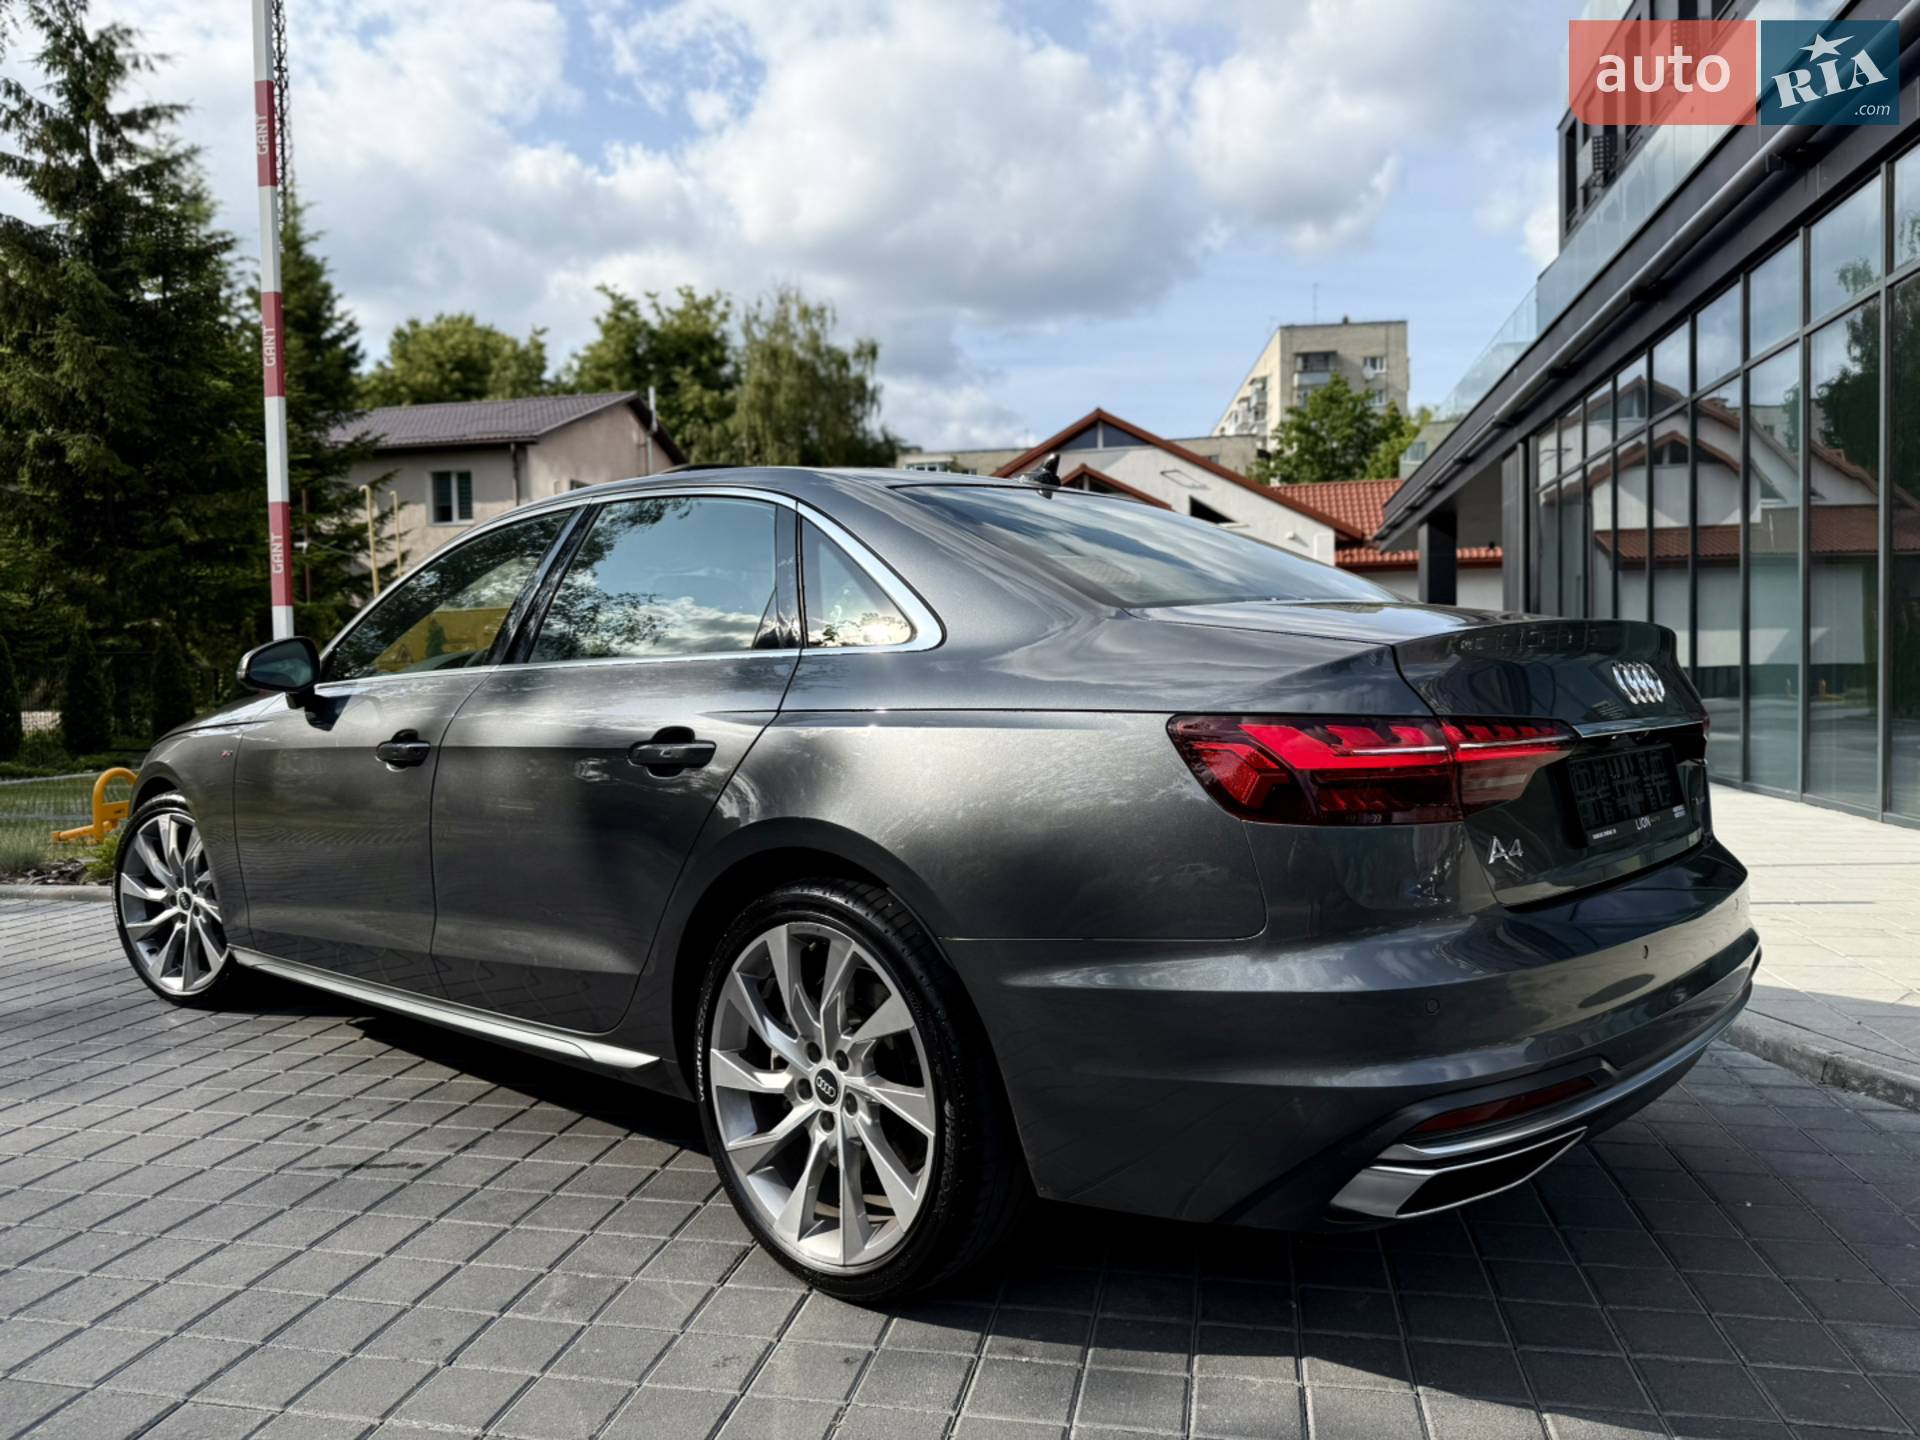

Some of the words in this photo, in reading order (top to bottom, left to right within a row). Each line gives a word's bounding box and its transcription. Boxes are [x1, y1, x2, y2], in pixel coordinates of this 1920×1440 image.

[262, 325, 275, 367] GANT
[270, 532, 284, 574] GANT
[1635, 815, 1652, 831] LION
[1488, 835, 1524, 865] A4
